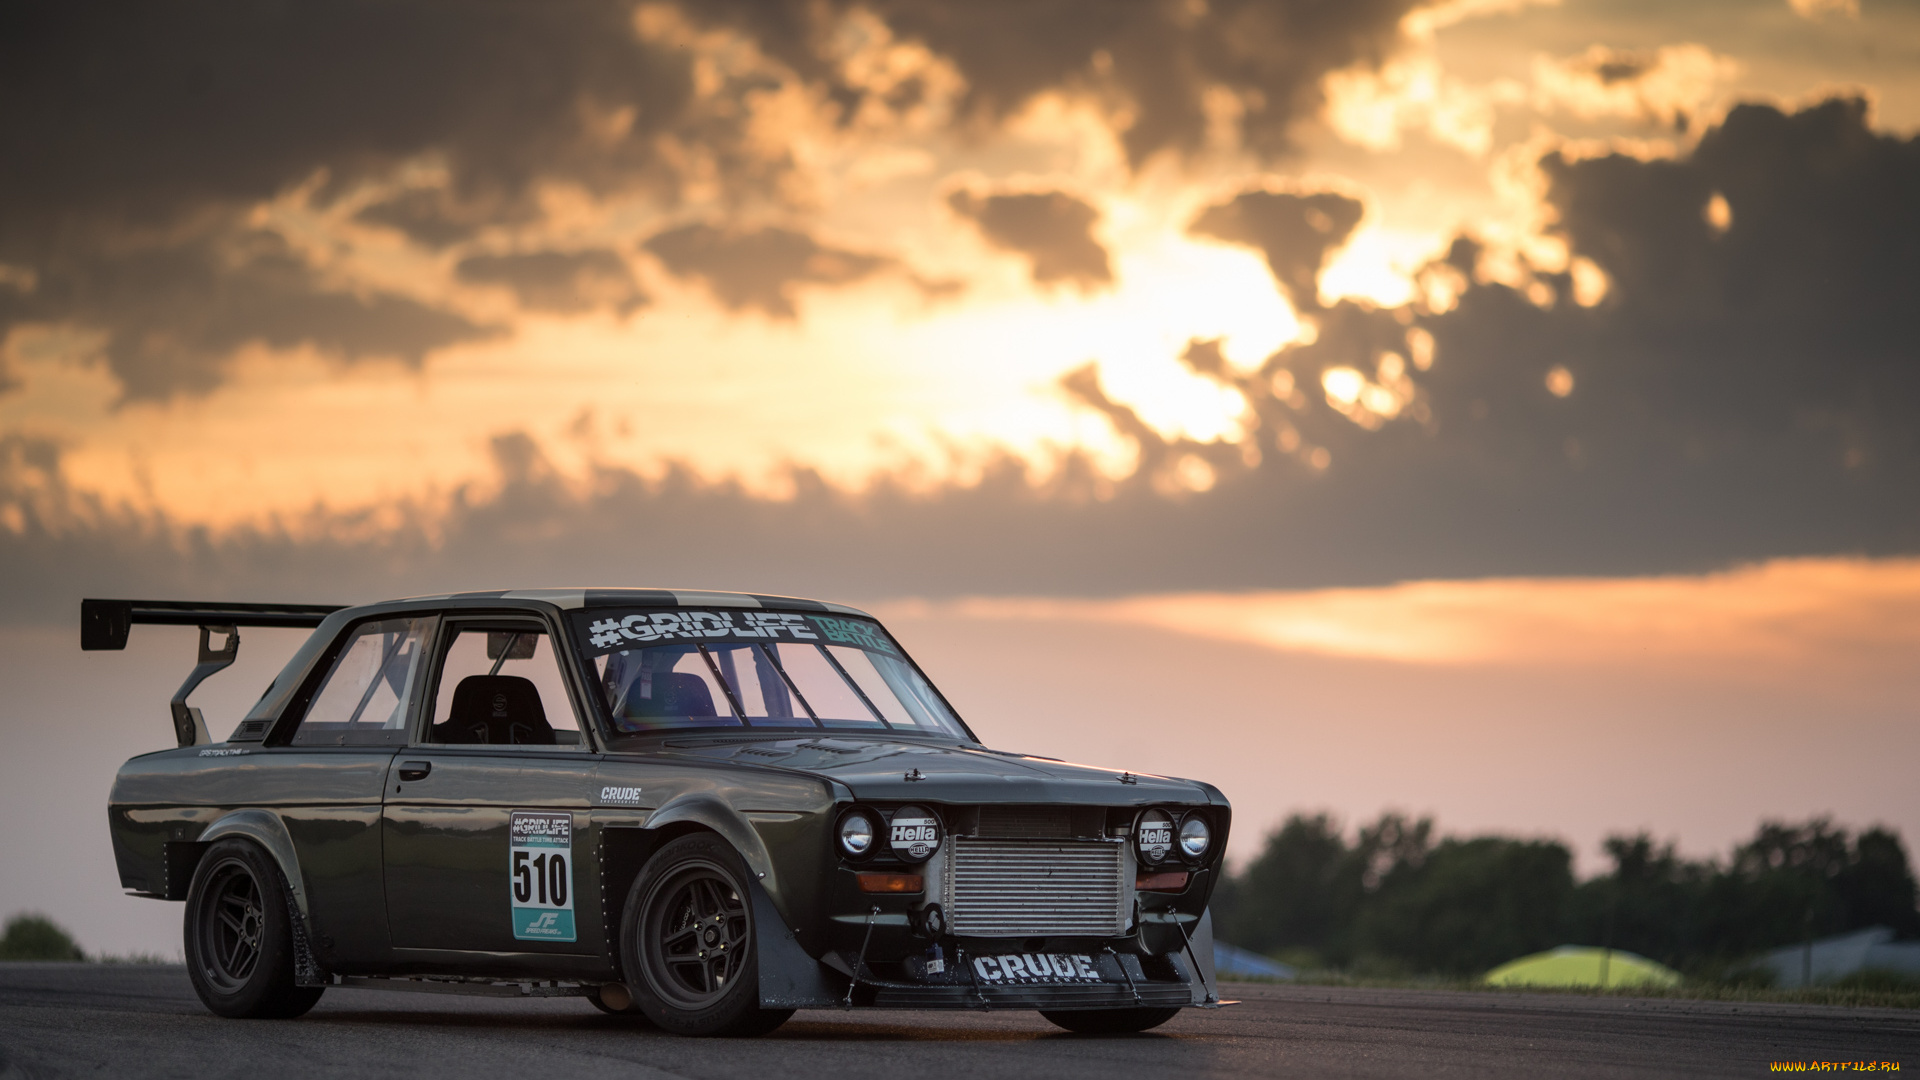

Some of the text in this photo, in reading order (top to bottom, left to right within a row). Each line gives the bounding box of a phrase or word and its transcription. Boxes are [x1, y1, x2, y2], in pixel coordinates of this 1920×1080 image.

[588, 611, 819, 649] #GRIDLIFE
[805, 615, 877, 637] TRACK
[822, 629, 897, 655] BATTLE
[601, 786, 642, 800] CRUDE
[512, 817, 569, 835] #GRIDLIFE
[890, 826, 936, 841] Hella
[1139, 829, 1171, 844] Hella
[513, 851, 567, 907] 510
[973, 953, 1100, 980] CRUDE
